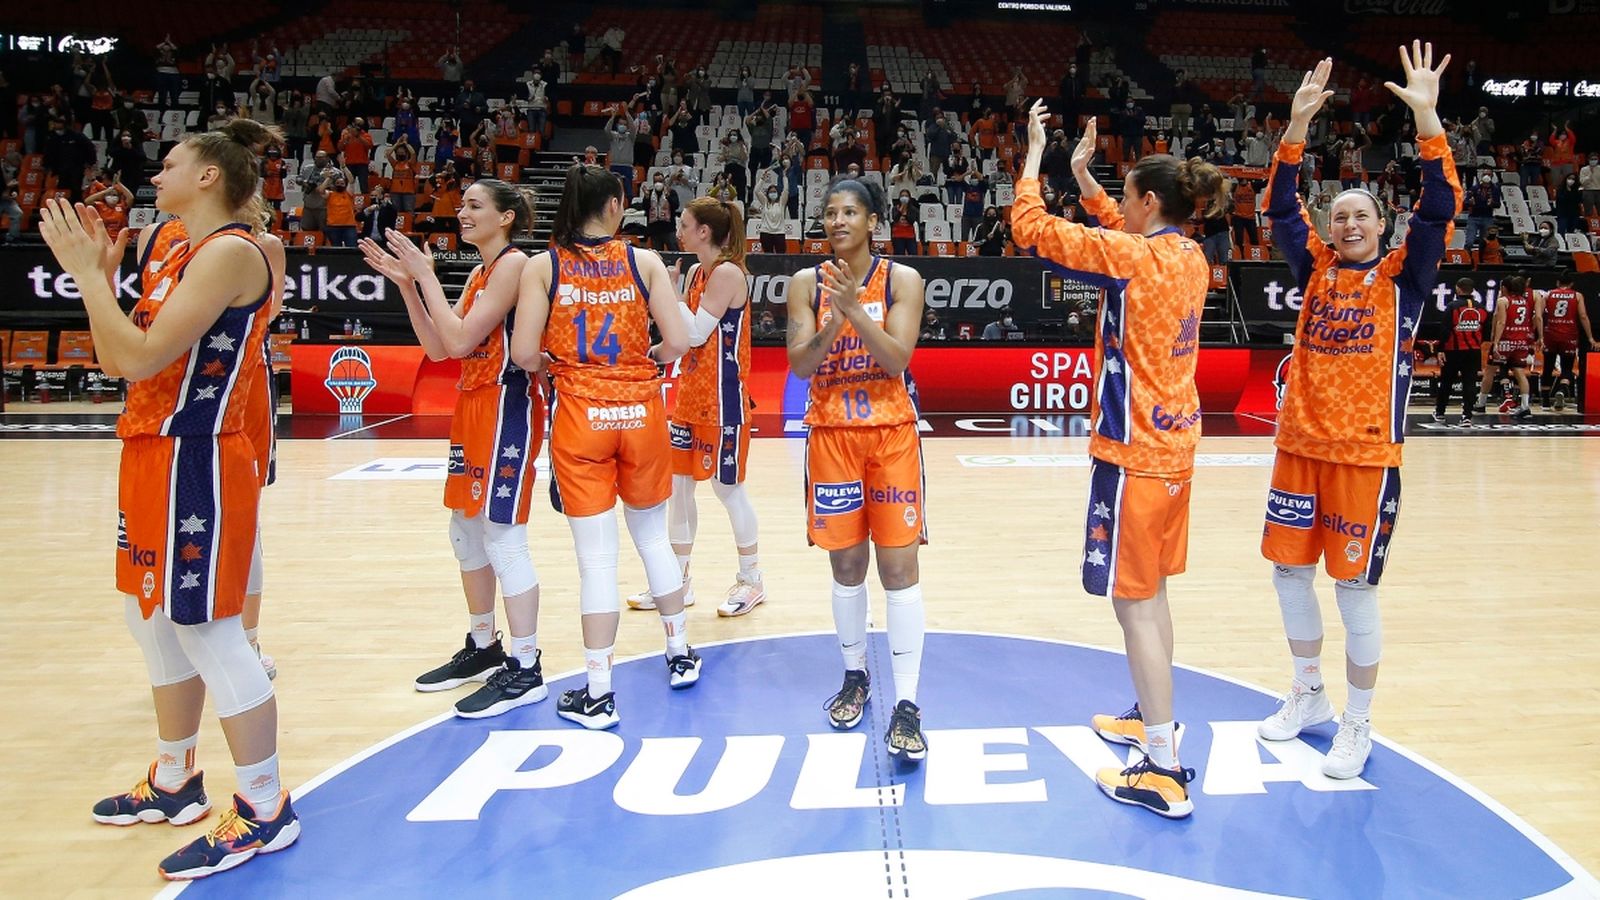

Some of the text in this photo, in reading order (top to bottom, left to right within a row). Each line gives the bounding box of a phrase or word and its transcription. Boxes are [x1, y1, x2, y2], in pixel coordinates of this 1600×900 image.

[824, 95, 839, 105] 111
[432, 250, 482, 260] encia bask
[563, 259, 627, 279] CARRERA
[28, 265, 142, 298] tek
[582, 284, 636, 305] isaval
[923, 278, 1013, 309] erzo
[1062, 291, 1083, 302] Juan
[1514, 306, 1527, 325] 3
[1554, 300, 1569, 318] 8
[572, 309, 622, 366] 14
[960, 326, 970, 340] 5
[1031, 351, 1092, 379] SPA
[842, 389, 872, 420] 18
[1010, 383, 1089, 410] GIRO
[587, 403, 647, 421] PATESA
[465, 459, 484, 479] ika
[817, 485, 861, 498] PULEVA
[869, 485, 917, 504] teika
[1269, 492, 1313, 510] PULEVA
[1322, 513, 1368, 539] eika
[404, 720, 1380, 823] PULEVA
